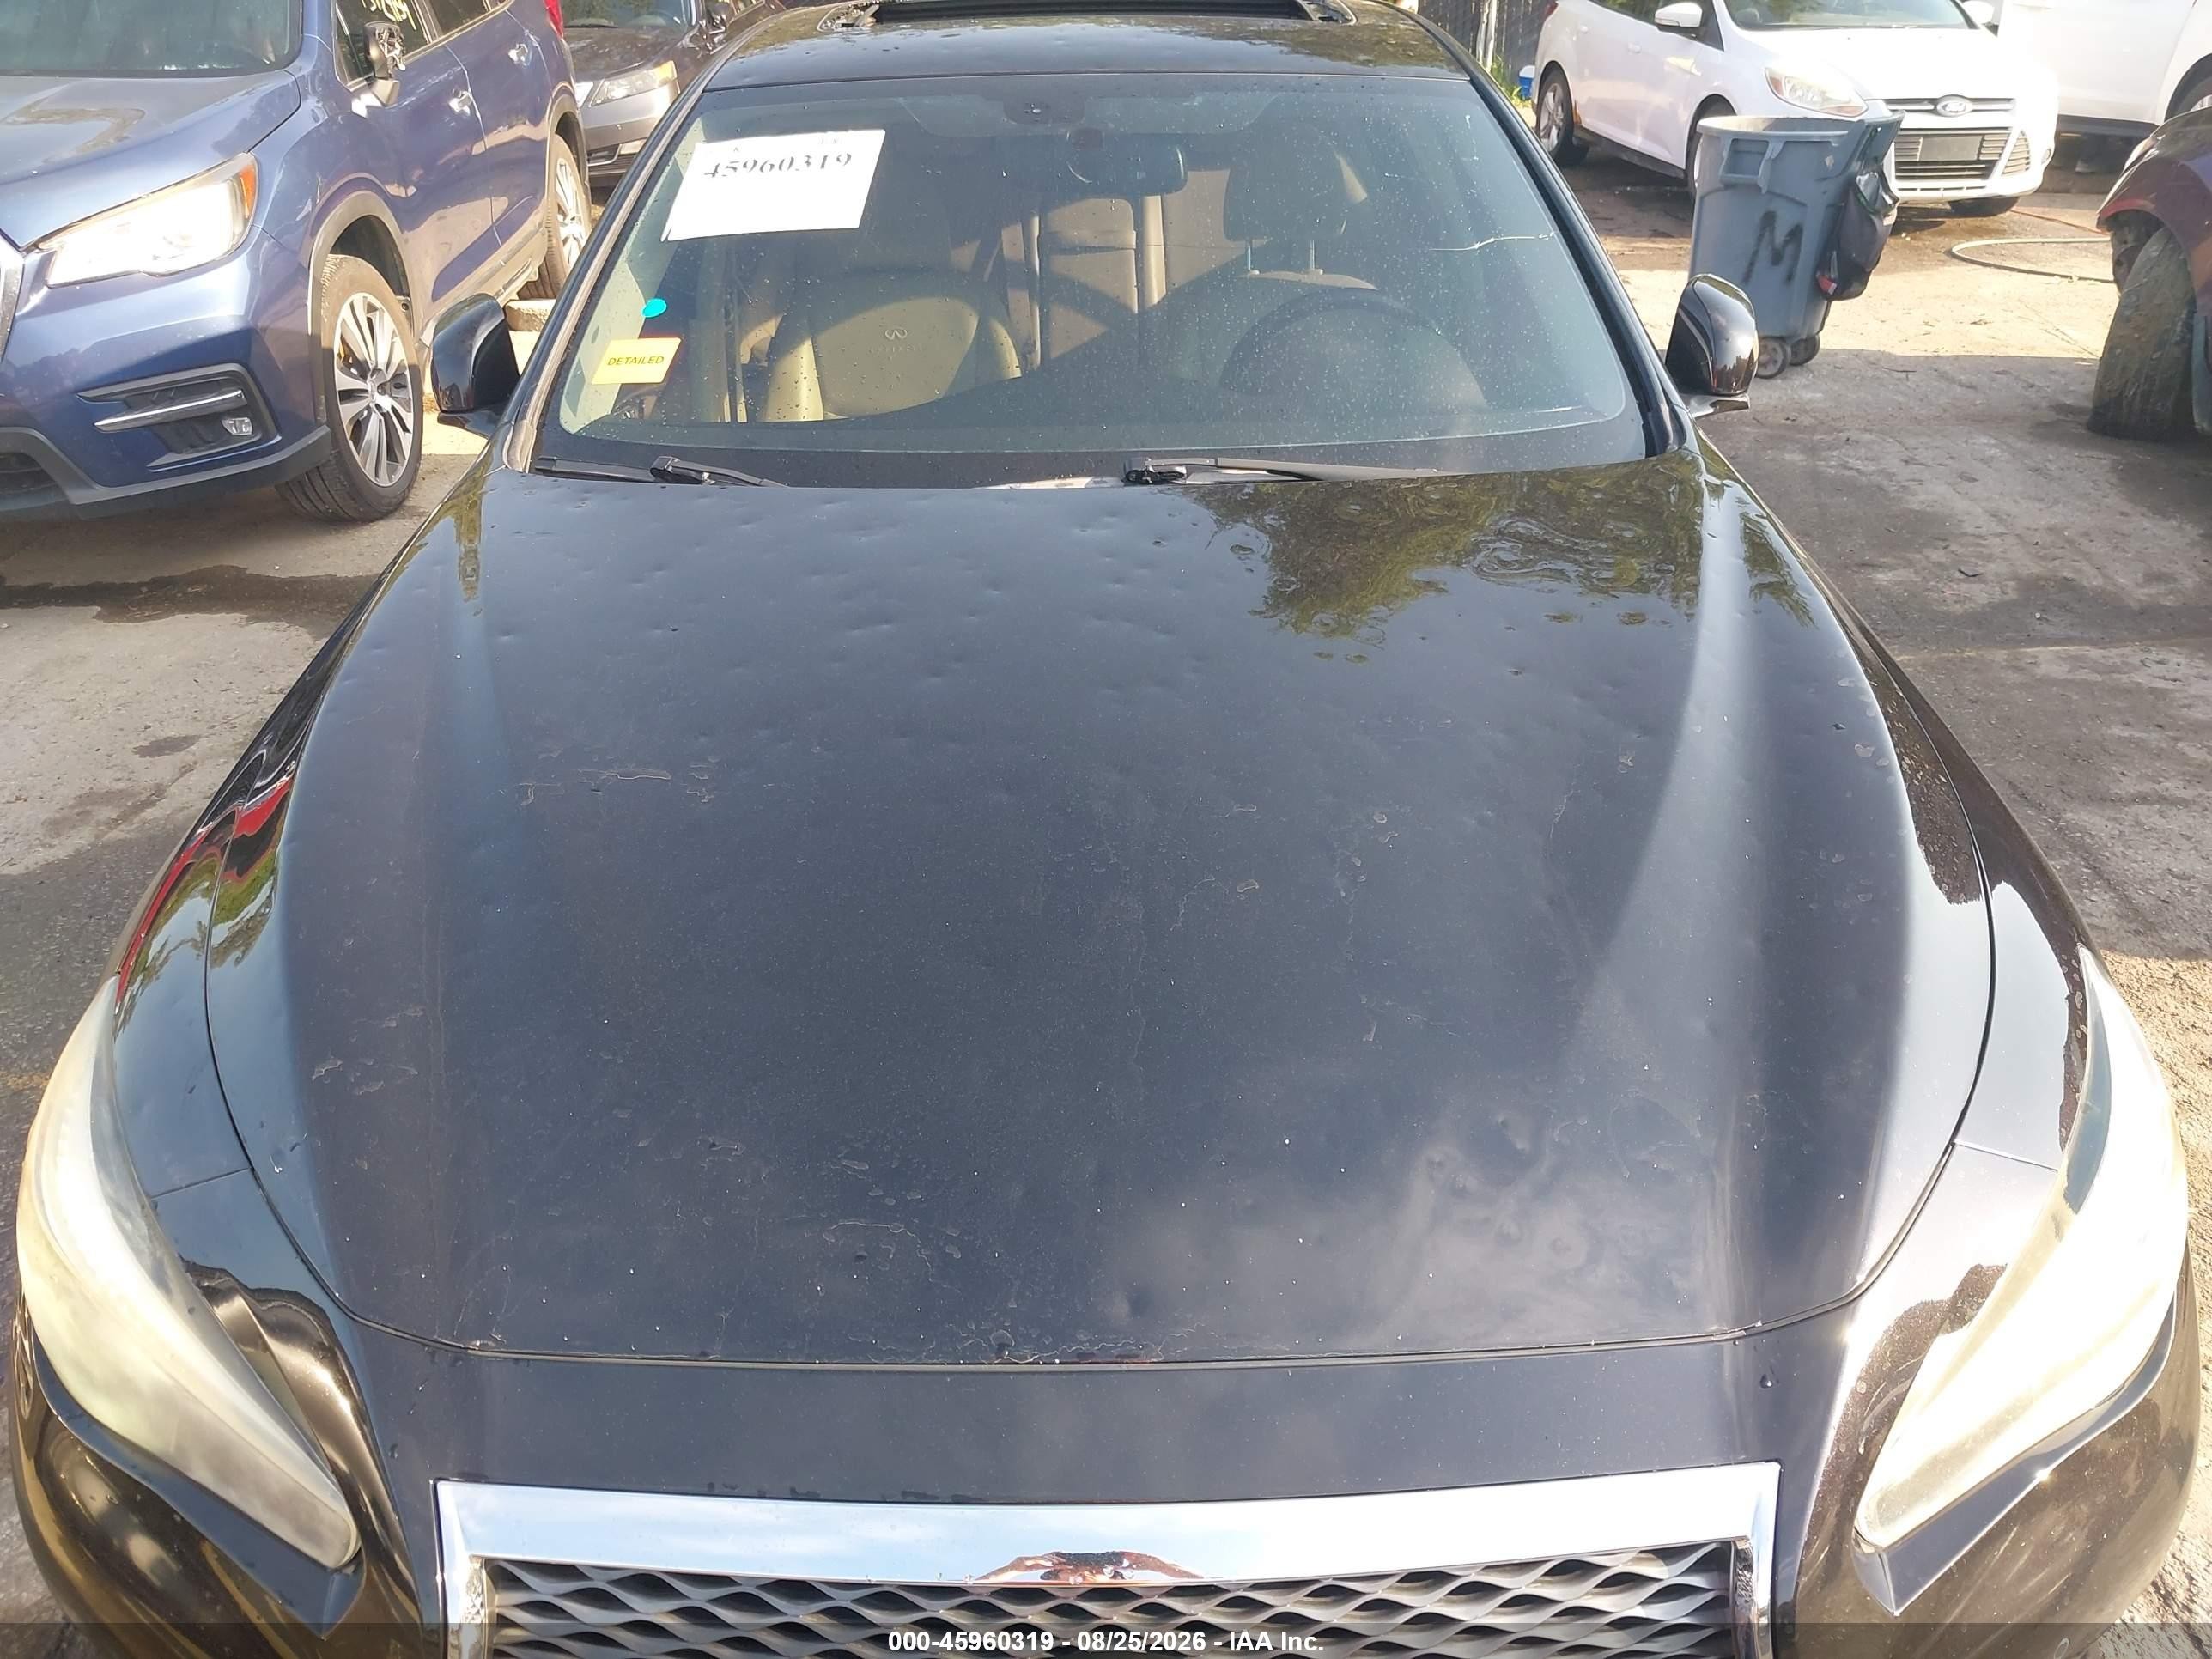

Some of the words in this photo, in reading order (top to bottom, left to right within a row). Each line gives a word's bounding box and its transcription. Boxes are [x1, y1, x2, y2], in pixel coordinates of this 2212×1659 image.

[703, 153, 852, 178] 45960319
[1741, 211, 1803, 285] M
[607, 356, 665, 366] DETAILED
